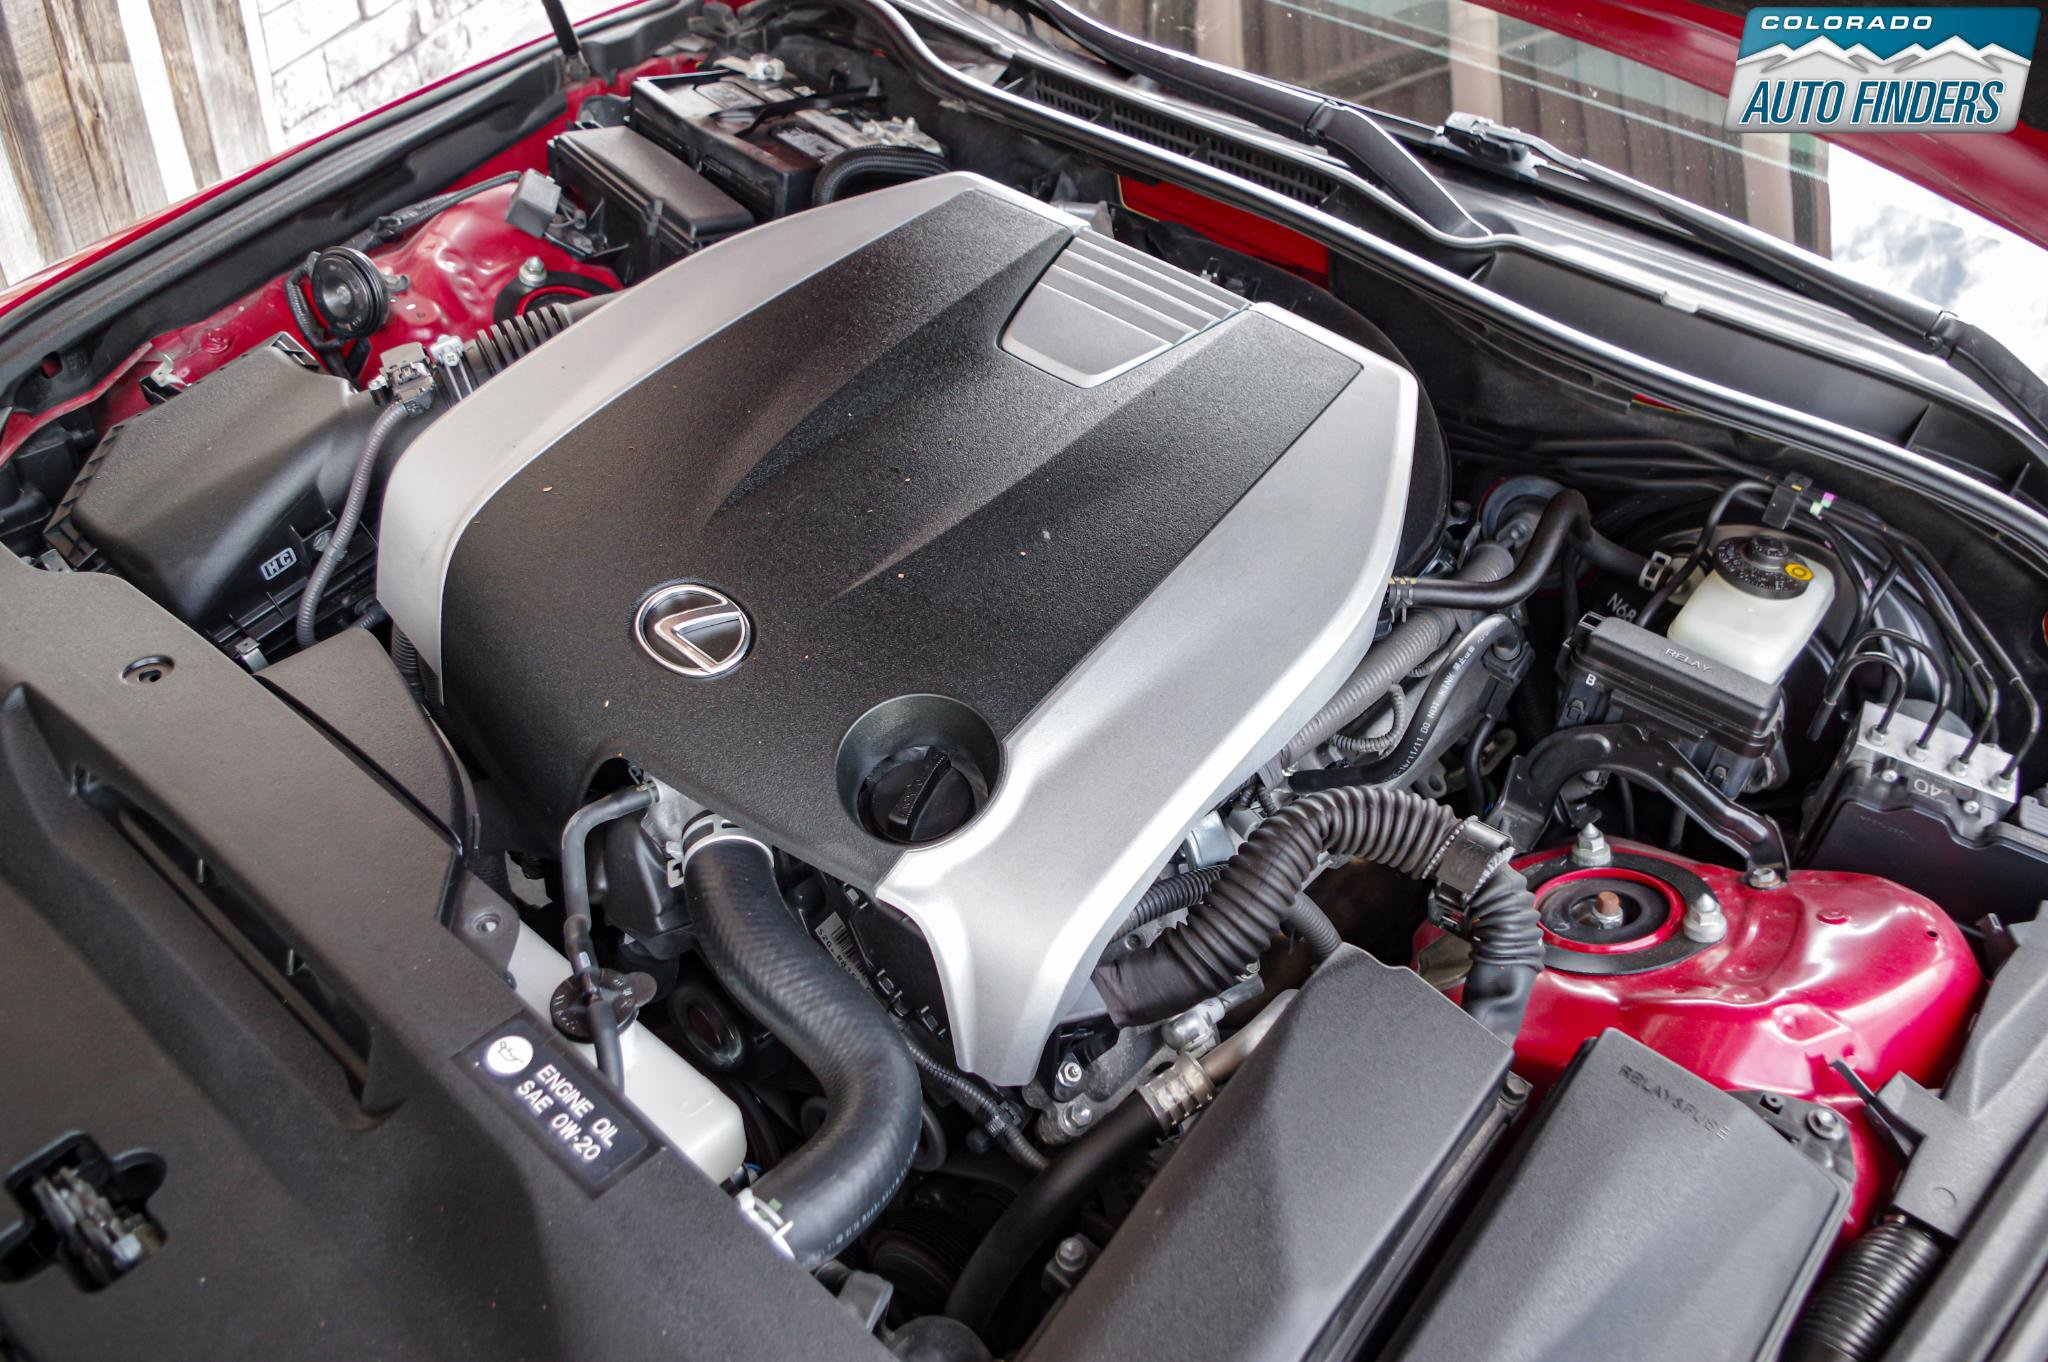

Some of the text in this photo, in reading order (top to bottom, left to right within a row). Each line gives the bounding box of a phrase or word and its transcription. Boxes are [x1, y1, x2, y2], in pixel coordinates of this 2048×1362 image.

[1585, 673, 1597, 687] B
[1665, 648, 1712, 673] RELAY
[517, 1079, 602, 1161] SAE 0W-20
[536, 1064, 596, 1118] ENGINE
[592, 1117, 619, 1149] OIL
